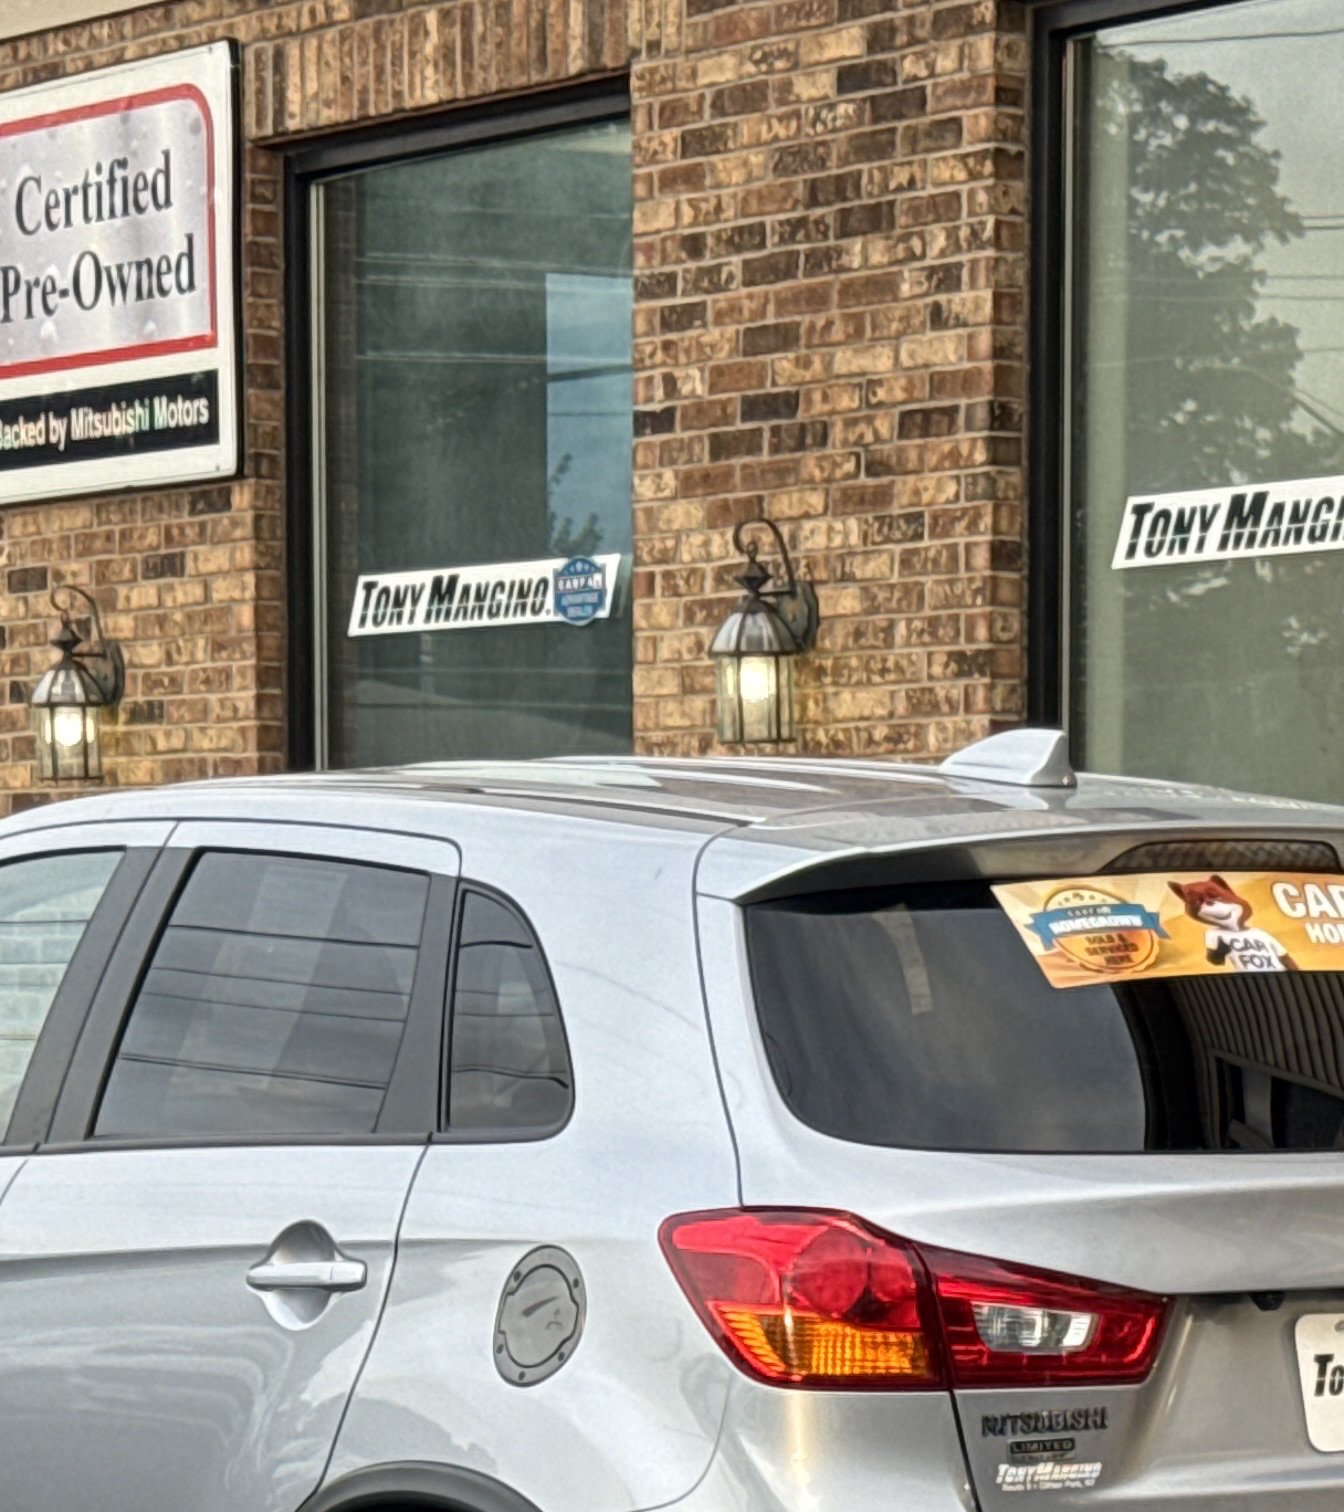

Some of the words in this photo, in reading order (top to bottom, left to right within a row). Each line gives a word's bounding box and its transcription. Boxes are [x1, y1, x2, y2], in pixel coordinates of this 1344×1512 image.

[15, 149, 173, 236] Certified
[0, 233, 196, 323] Pre-Owned
[49, 411, 67, 451] by
[70, 398, 150, 440] Mitsubishi
[153, 395, 209, 430] Motors
[1230, 938, 1268, 952] CAR
[1238, 954, 1276, 969] FOX
